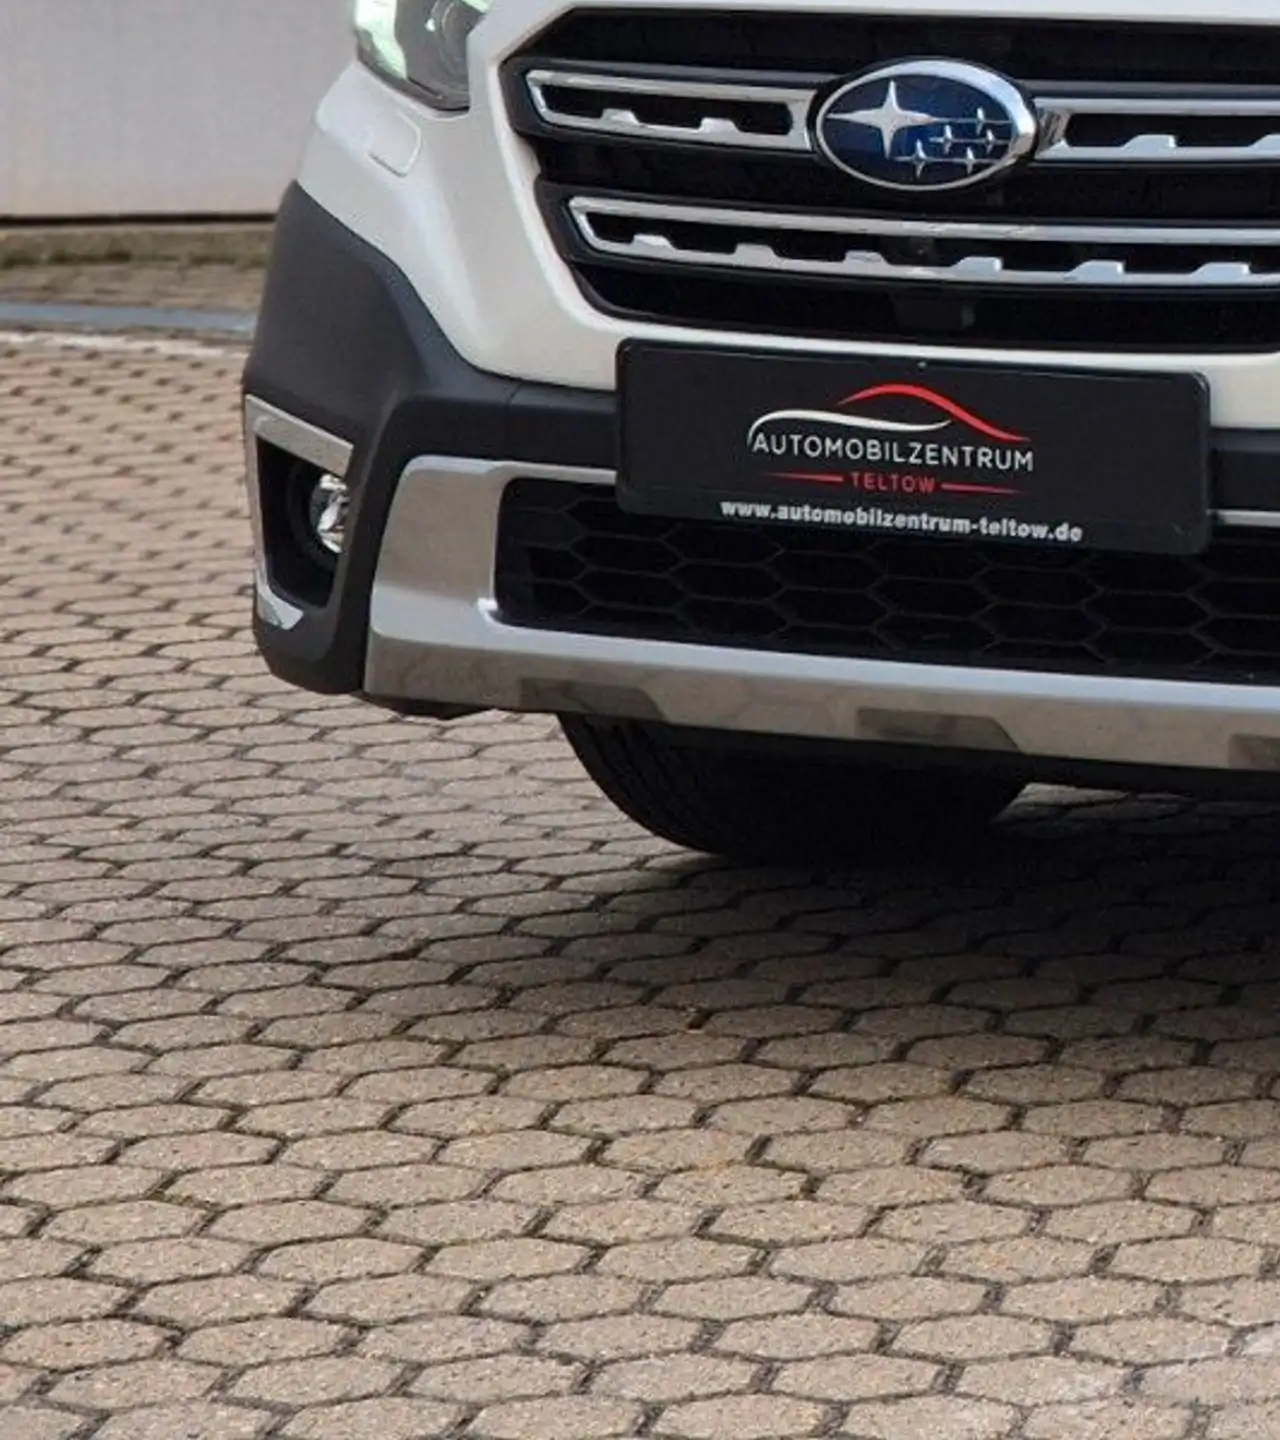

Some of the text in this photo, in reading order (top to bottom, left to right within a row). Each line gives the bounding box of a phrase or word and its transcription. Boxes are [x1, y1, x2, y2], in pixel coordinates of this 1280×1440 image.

[752, 431, 1033, 472] AUTOMOBILZENTRUM
[850, 471, 935, 495] TELTOW
[720, 500, 1083, 542] www.automobilzentrum-teltow.de
